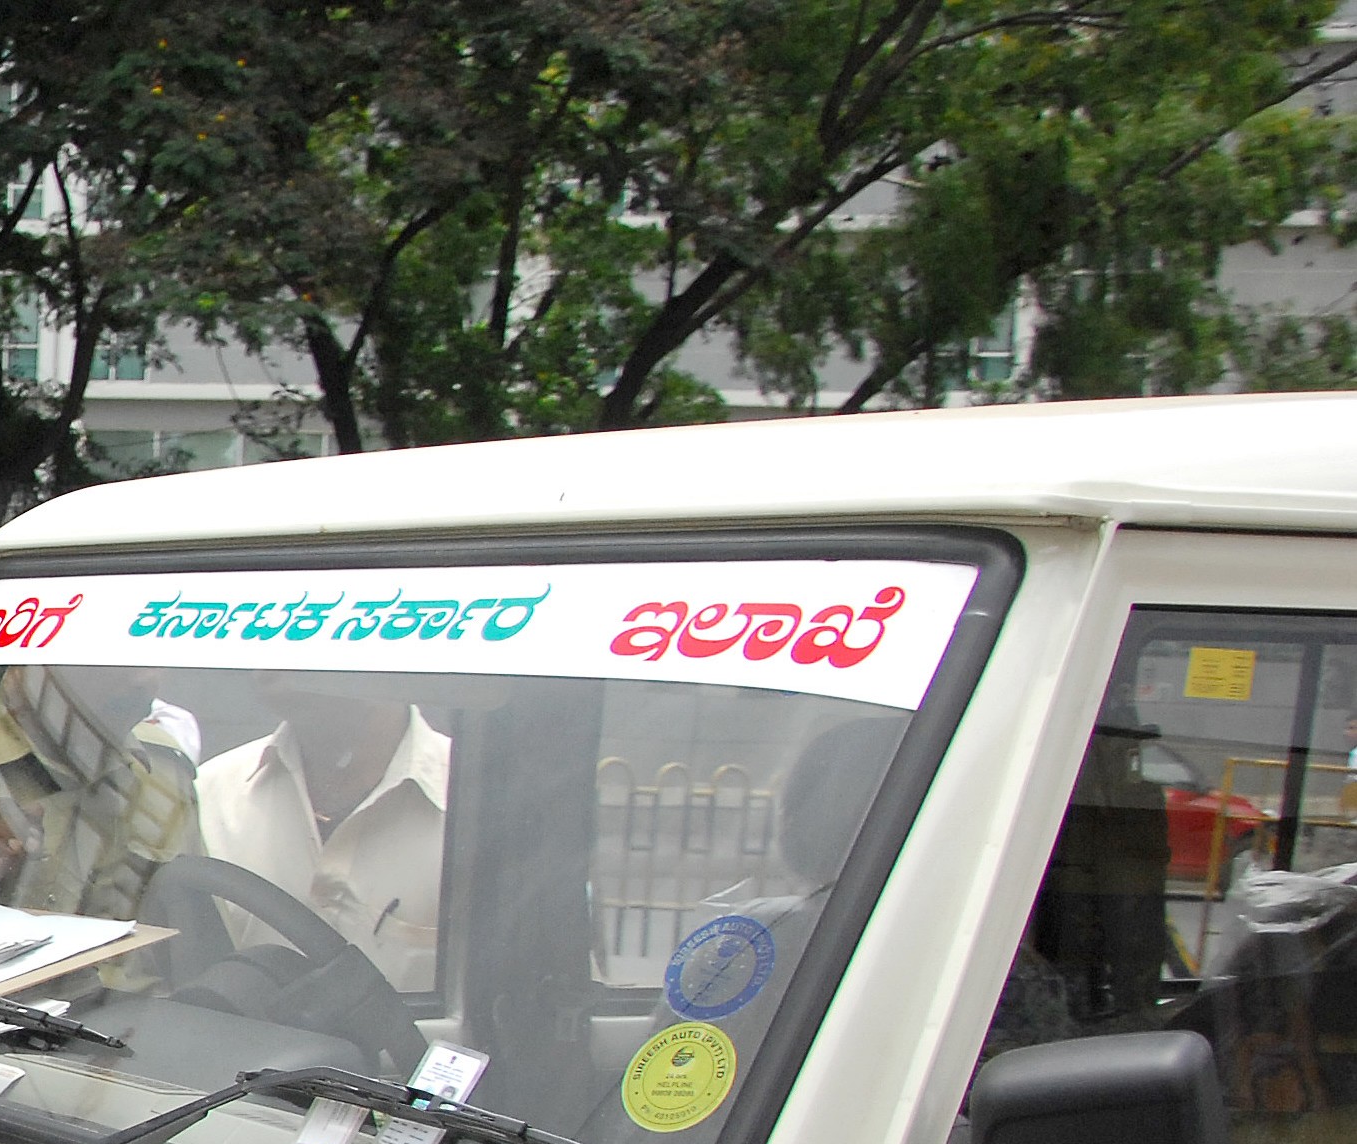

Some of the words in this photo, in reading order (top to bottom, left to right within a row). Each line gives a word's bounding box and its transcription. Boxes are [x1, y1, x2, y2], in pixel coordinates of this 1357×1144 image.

[128, 590, 345, 640] ಕರ್ನಾಟಕ
[331, 583, 551, 641] ಸರ್ಕಾರ
[609, 586, 905, 669] ಇಲಾಖೆ
[632, 1038, 668, 1080] SIREESH
[671, 1030, 701, 1041] AUTO
